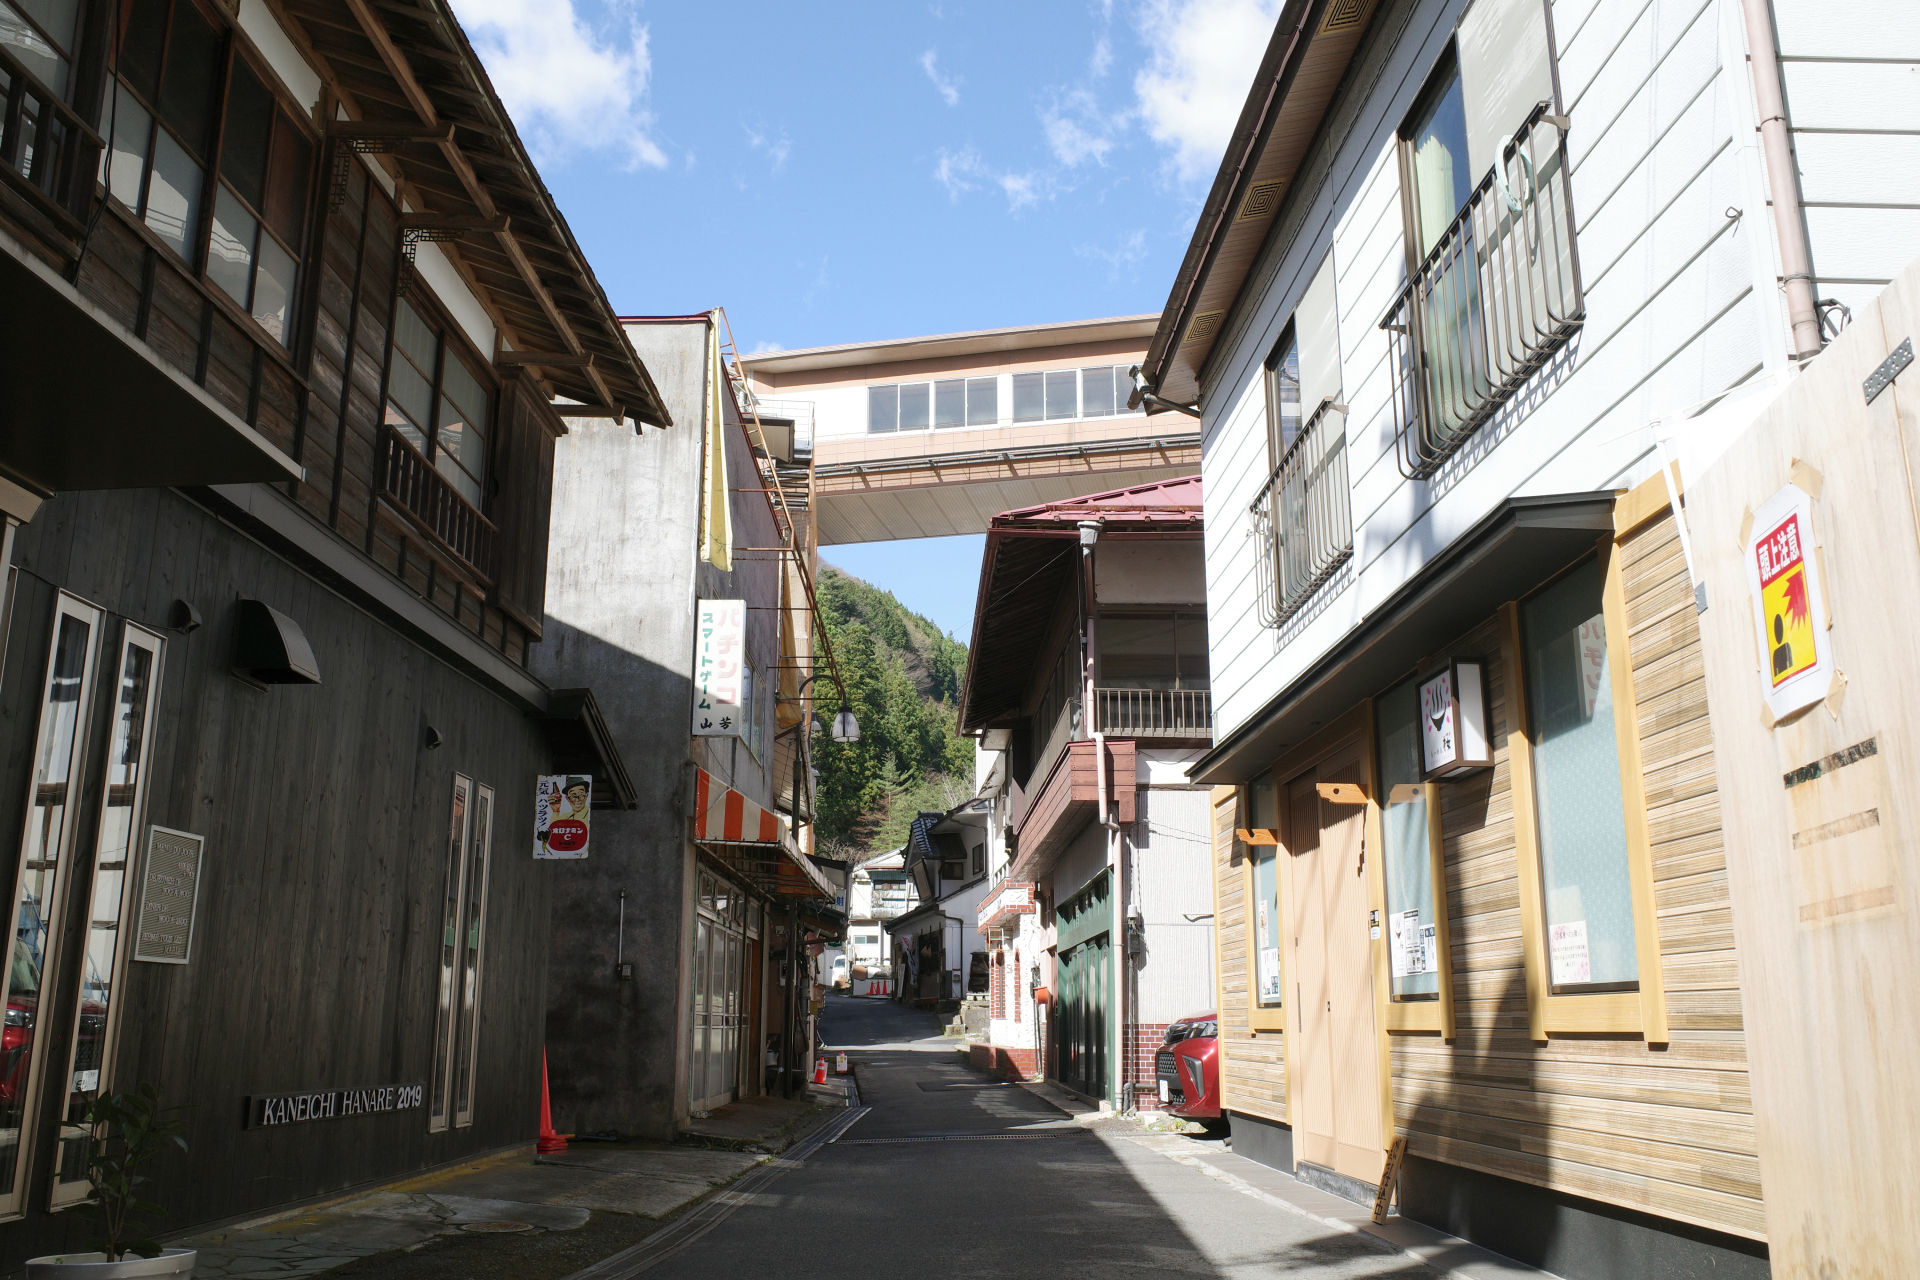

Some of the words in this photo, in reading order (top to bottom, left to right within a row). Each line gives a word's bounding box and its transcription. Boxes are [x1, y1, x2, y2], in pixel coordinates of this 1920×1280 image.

[1758, 523, 1800, 582] 頭上注意
[698, 612, 713, 710] スマートゲーム
[716, 608, 740, 705] パチンコ
[263, 1092, 336, 1126] KANEICHI
[341, 1087, 394, 1116] HANARE
[396, 1084, 422, 1110] 2019
